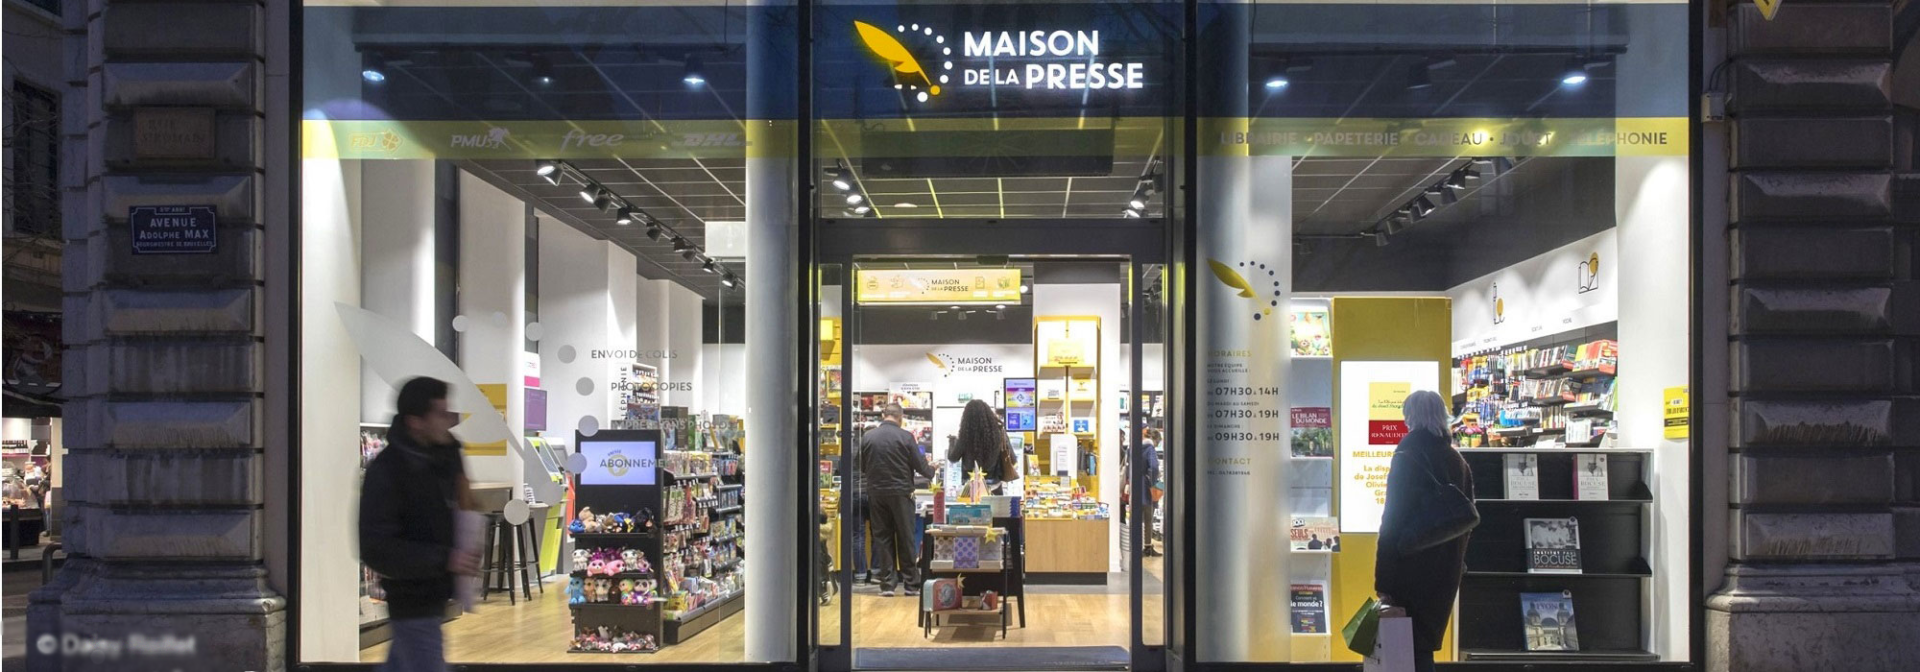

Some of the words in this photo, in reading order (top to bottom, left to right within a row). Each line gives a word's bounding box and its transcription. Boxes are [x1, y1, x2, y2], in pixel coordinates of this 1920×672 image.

[964, 30, 1099, 57] MAISON
[964, 69, 989, 85] DE
[995, 69, 1020, 85] LA
[1025, 63, 1144, 89] PRESSE
[451, 134, 486, 148] PMU
[560, 129, 625, 153] free
[682, 132, 744, 147] DHL
[1221, 131, 1298, 145] LIBRAIRIE
[1314, 132, 1398, 146] PAPETERIE
[1415, 131, 1483, 146] CADEAU
[150, 217, 197, 228] AVENUE
[139, 230, 180, 240] ADOLPHE
[184, 229, 209, 239] MAX
[591, 349, 627, 359] ENVOI
[629, 349, 643, 359] DE
[645, 349, 678, 359] COLIS
[957, 357, 992, 365] MAISON
[972, 365, 1003, 373] PRESSE
[611, 382, 692, 391] PHOTOCOPIES
[1215, 386, 1252, 396] 07H30
[1258, 386, 1279, 396] 14H
[619, 367, 628, 421] LÉPHONIE
[1215, 409, 1252, 418] 07H30
[1258, 409, 1279, 418] 19H
[1215, 432, 1253, 441] 09H30
[1259, 432, 1280, 441] 19H
[599, 458, 677, 468] ABONNEME
[1207, 457, 1251, 465] CONTACT
[1374, 465, 1391, 473] disp
[1533, 554, 1578, 565] BOCUSE
[1298, 600, 1319, 608] monde
